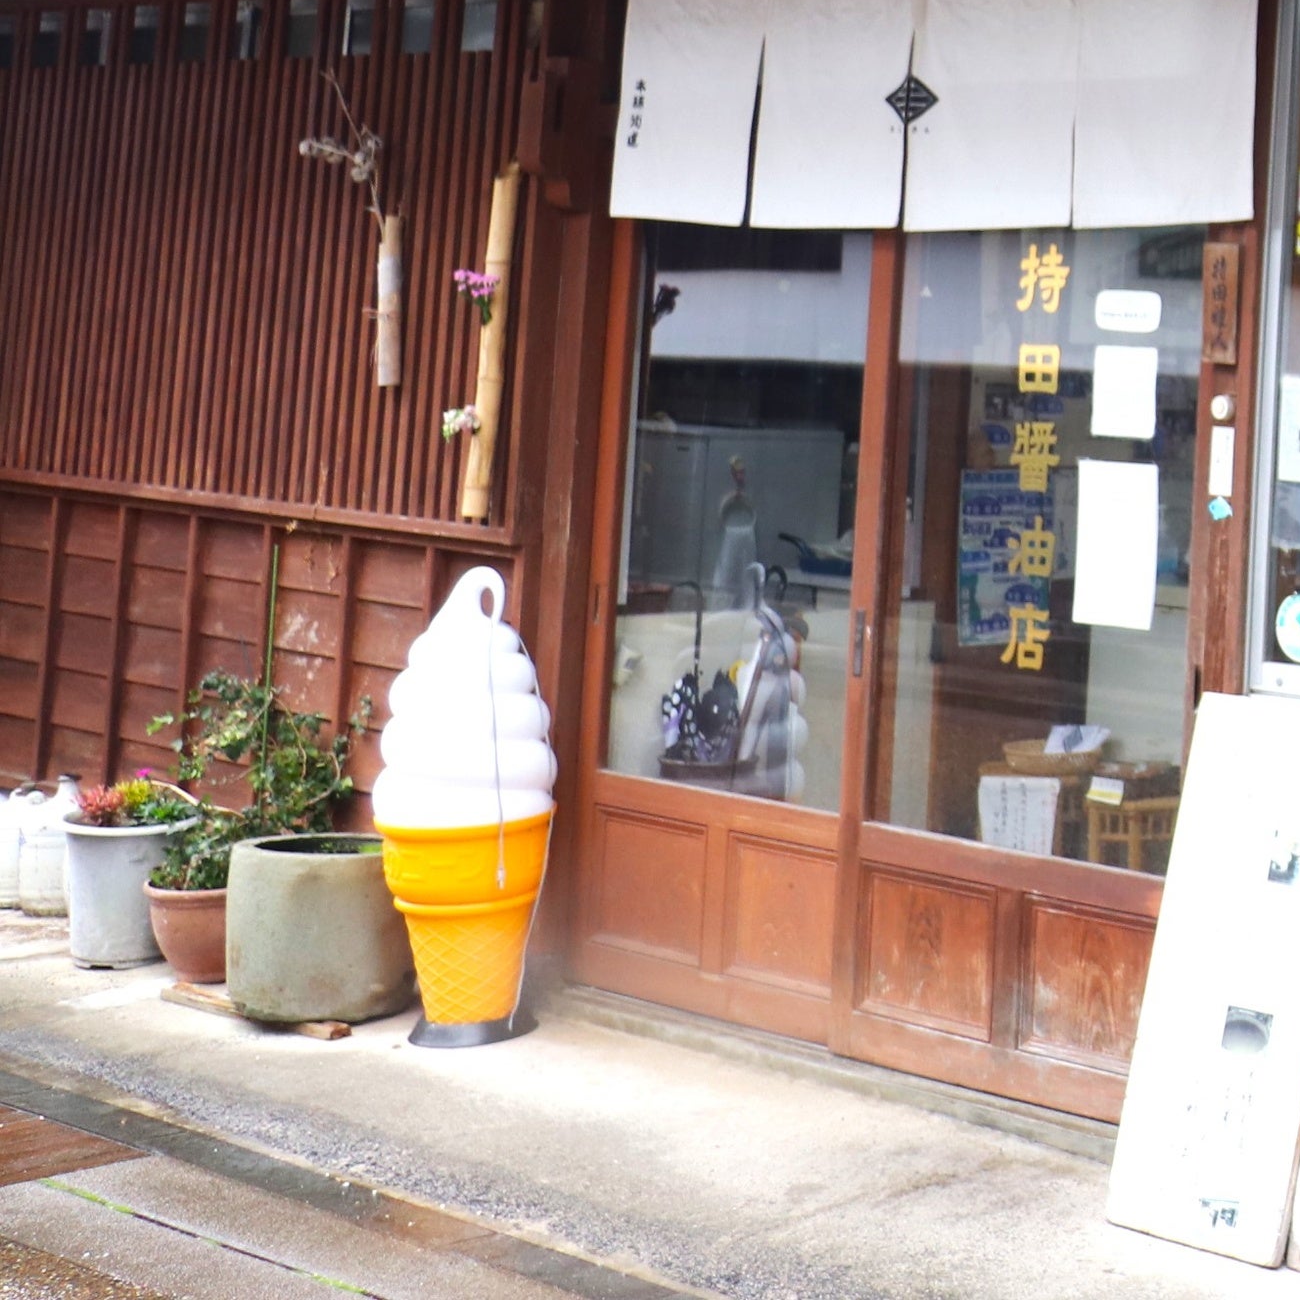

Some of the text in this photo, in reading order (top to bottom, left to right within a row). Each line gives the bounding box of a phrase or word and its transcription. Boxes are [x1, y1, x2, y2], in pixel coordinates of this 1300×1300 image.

[1001, 243, 1070, 671] 持田醤油店
